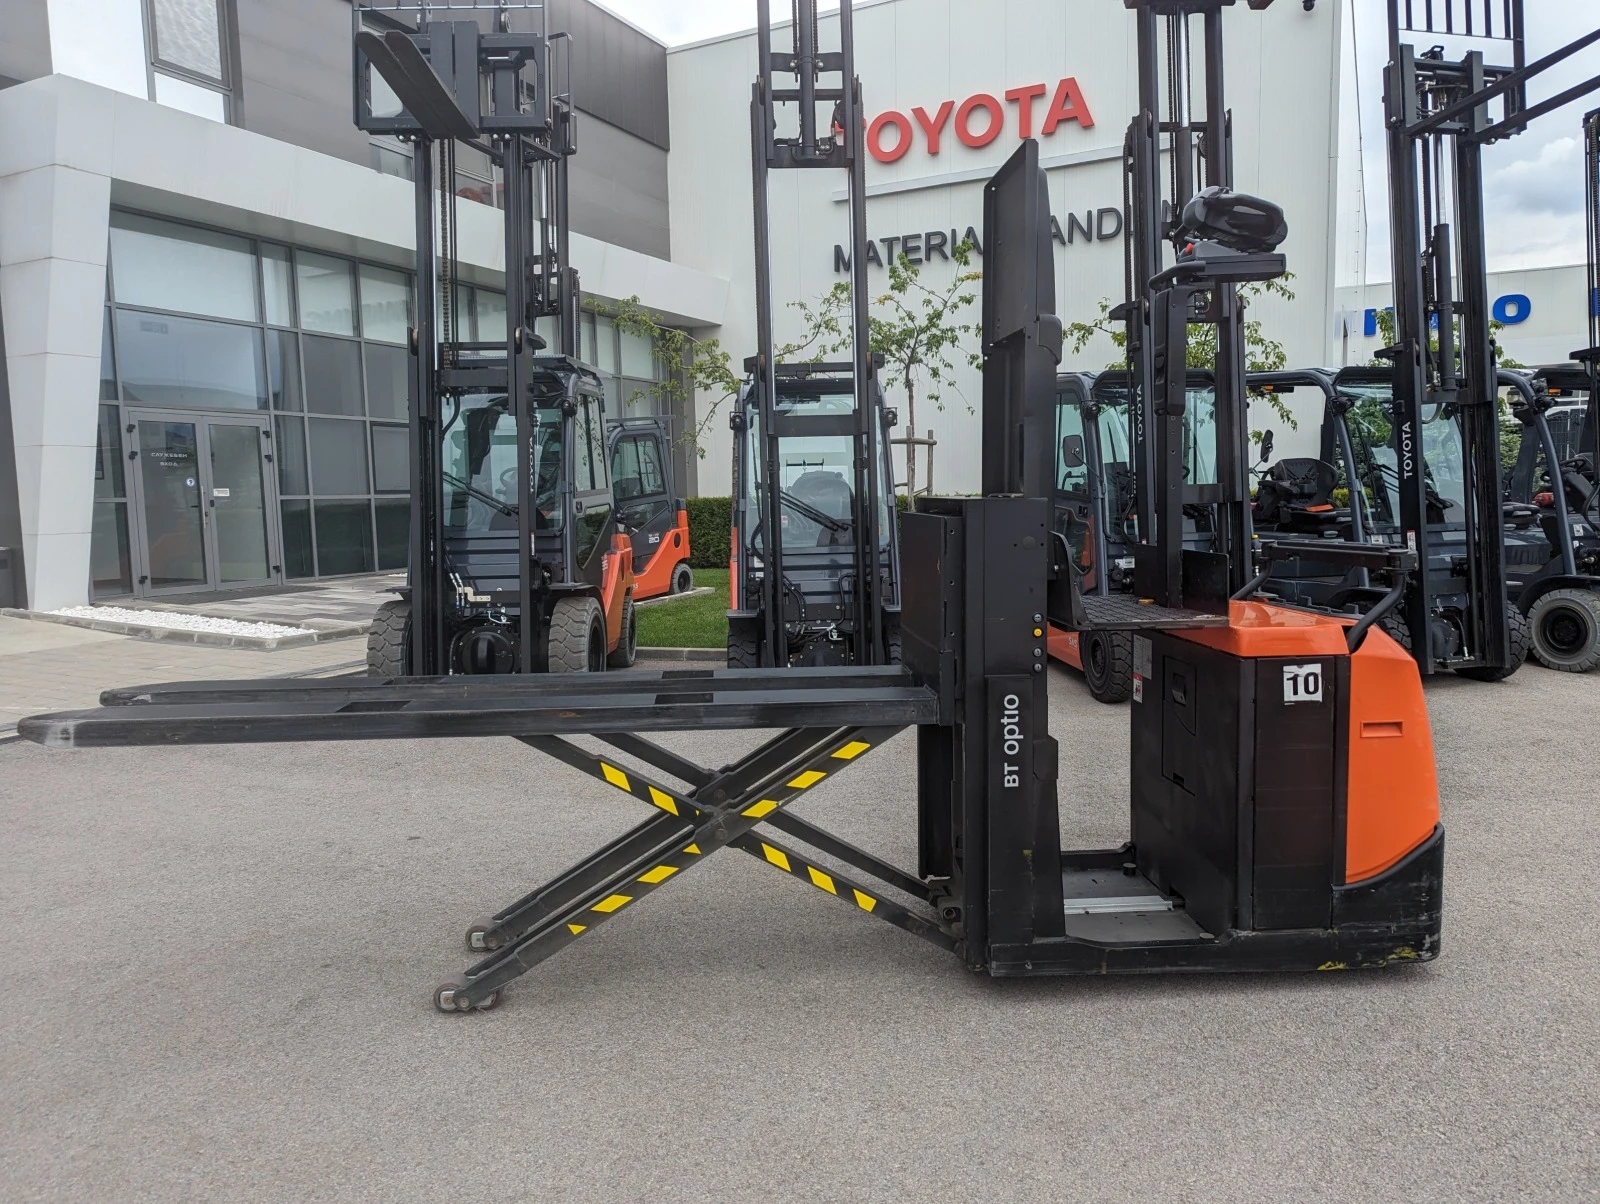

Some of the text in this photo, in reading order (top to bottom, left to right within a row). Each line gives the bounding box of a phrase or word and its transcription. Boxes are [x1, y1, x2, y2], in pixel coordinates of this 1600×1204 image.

[834, 77, 1095, 163] OYOTA
[1402, 421, 1413, 480] TOYOTA
[1286, 672, 1320, 696] 10
[1000, 694, 1024, 788] BT optio
